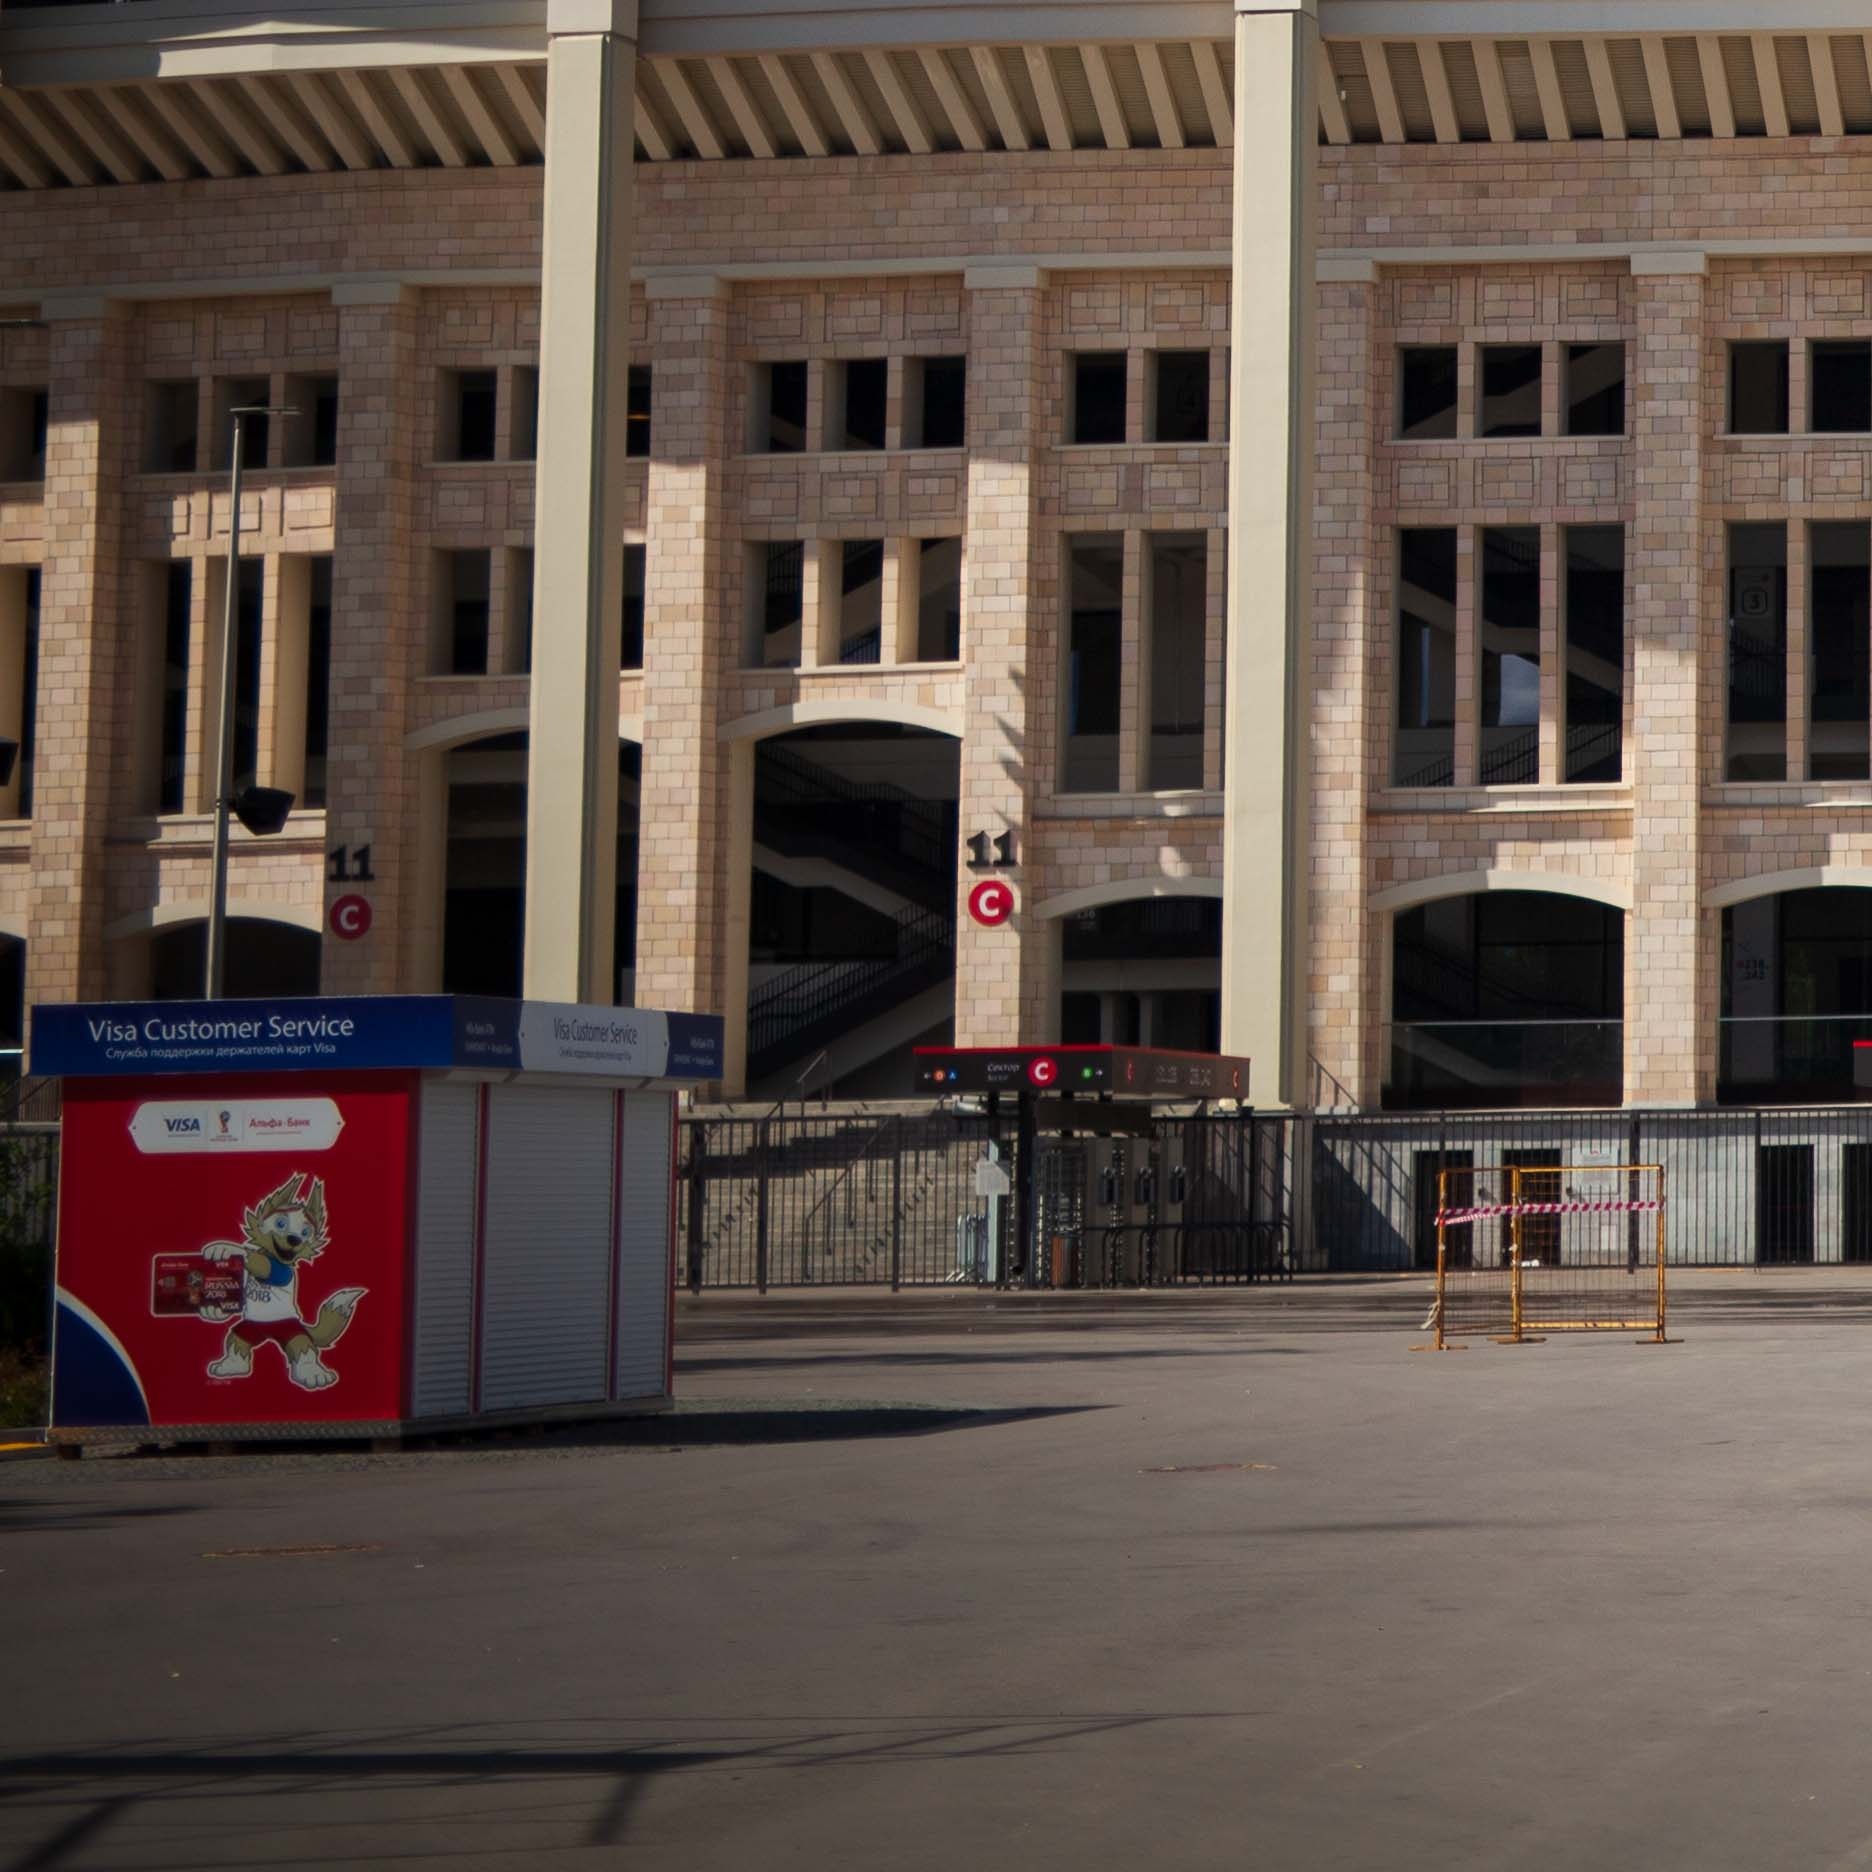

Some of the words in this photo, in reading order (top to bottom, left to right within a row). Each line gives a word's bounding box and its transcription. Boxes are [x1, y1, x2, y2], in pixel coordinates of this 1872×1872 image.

[966, 829, 1018, 869] 11
[329, 844, 375, 883] 11
[89, 1019, 137, 1042] Visa
[145, 1018, 262, 1040] Customer
[268, 1015, 354, 1039] Service
[571, 1020, 609, 1043] Customer
[610, 1022, 638, 1045] Service
[105, 1047, 148, 1059] Служба
[150, 1045, 214, 1058] поддержки
[216, 1043, 284, 1057] держателей
[286, 1044, 312, 1055] карт
[313, 1042, 337, 1054] Visa
[164, 1117, 200, 1132] VISA
